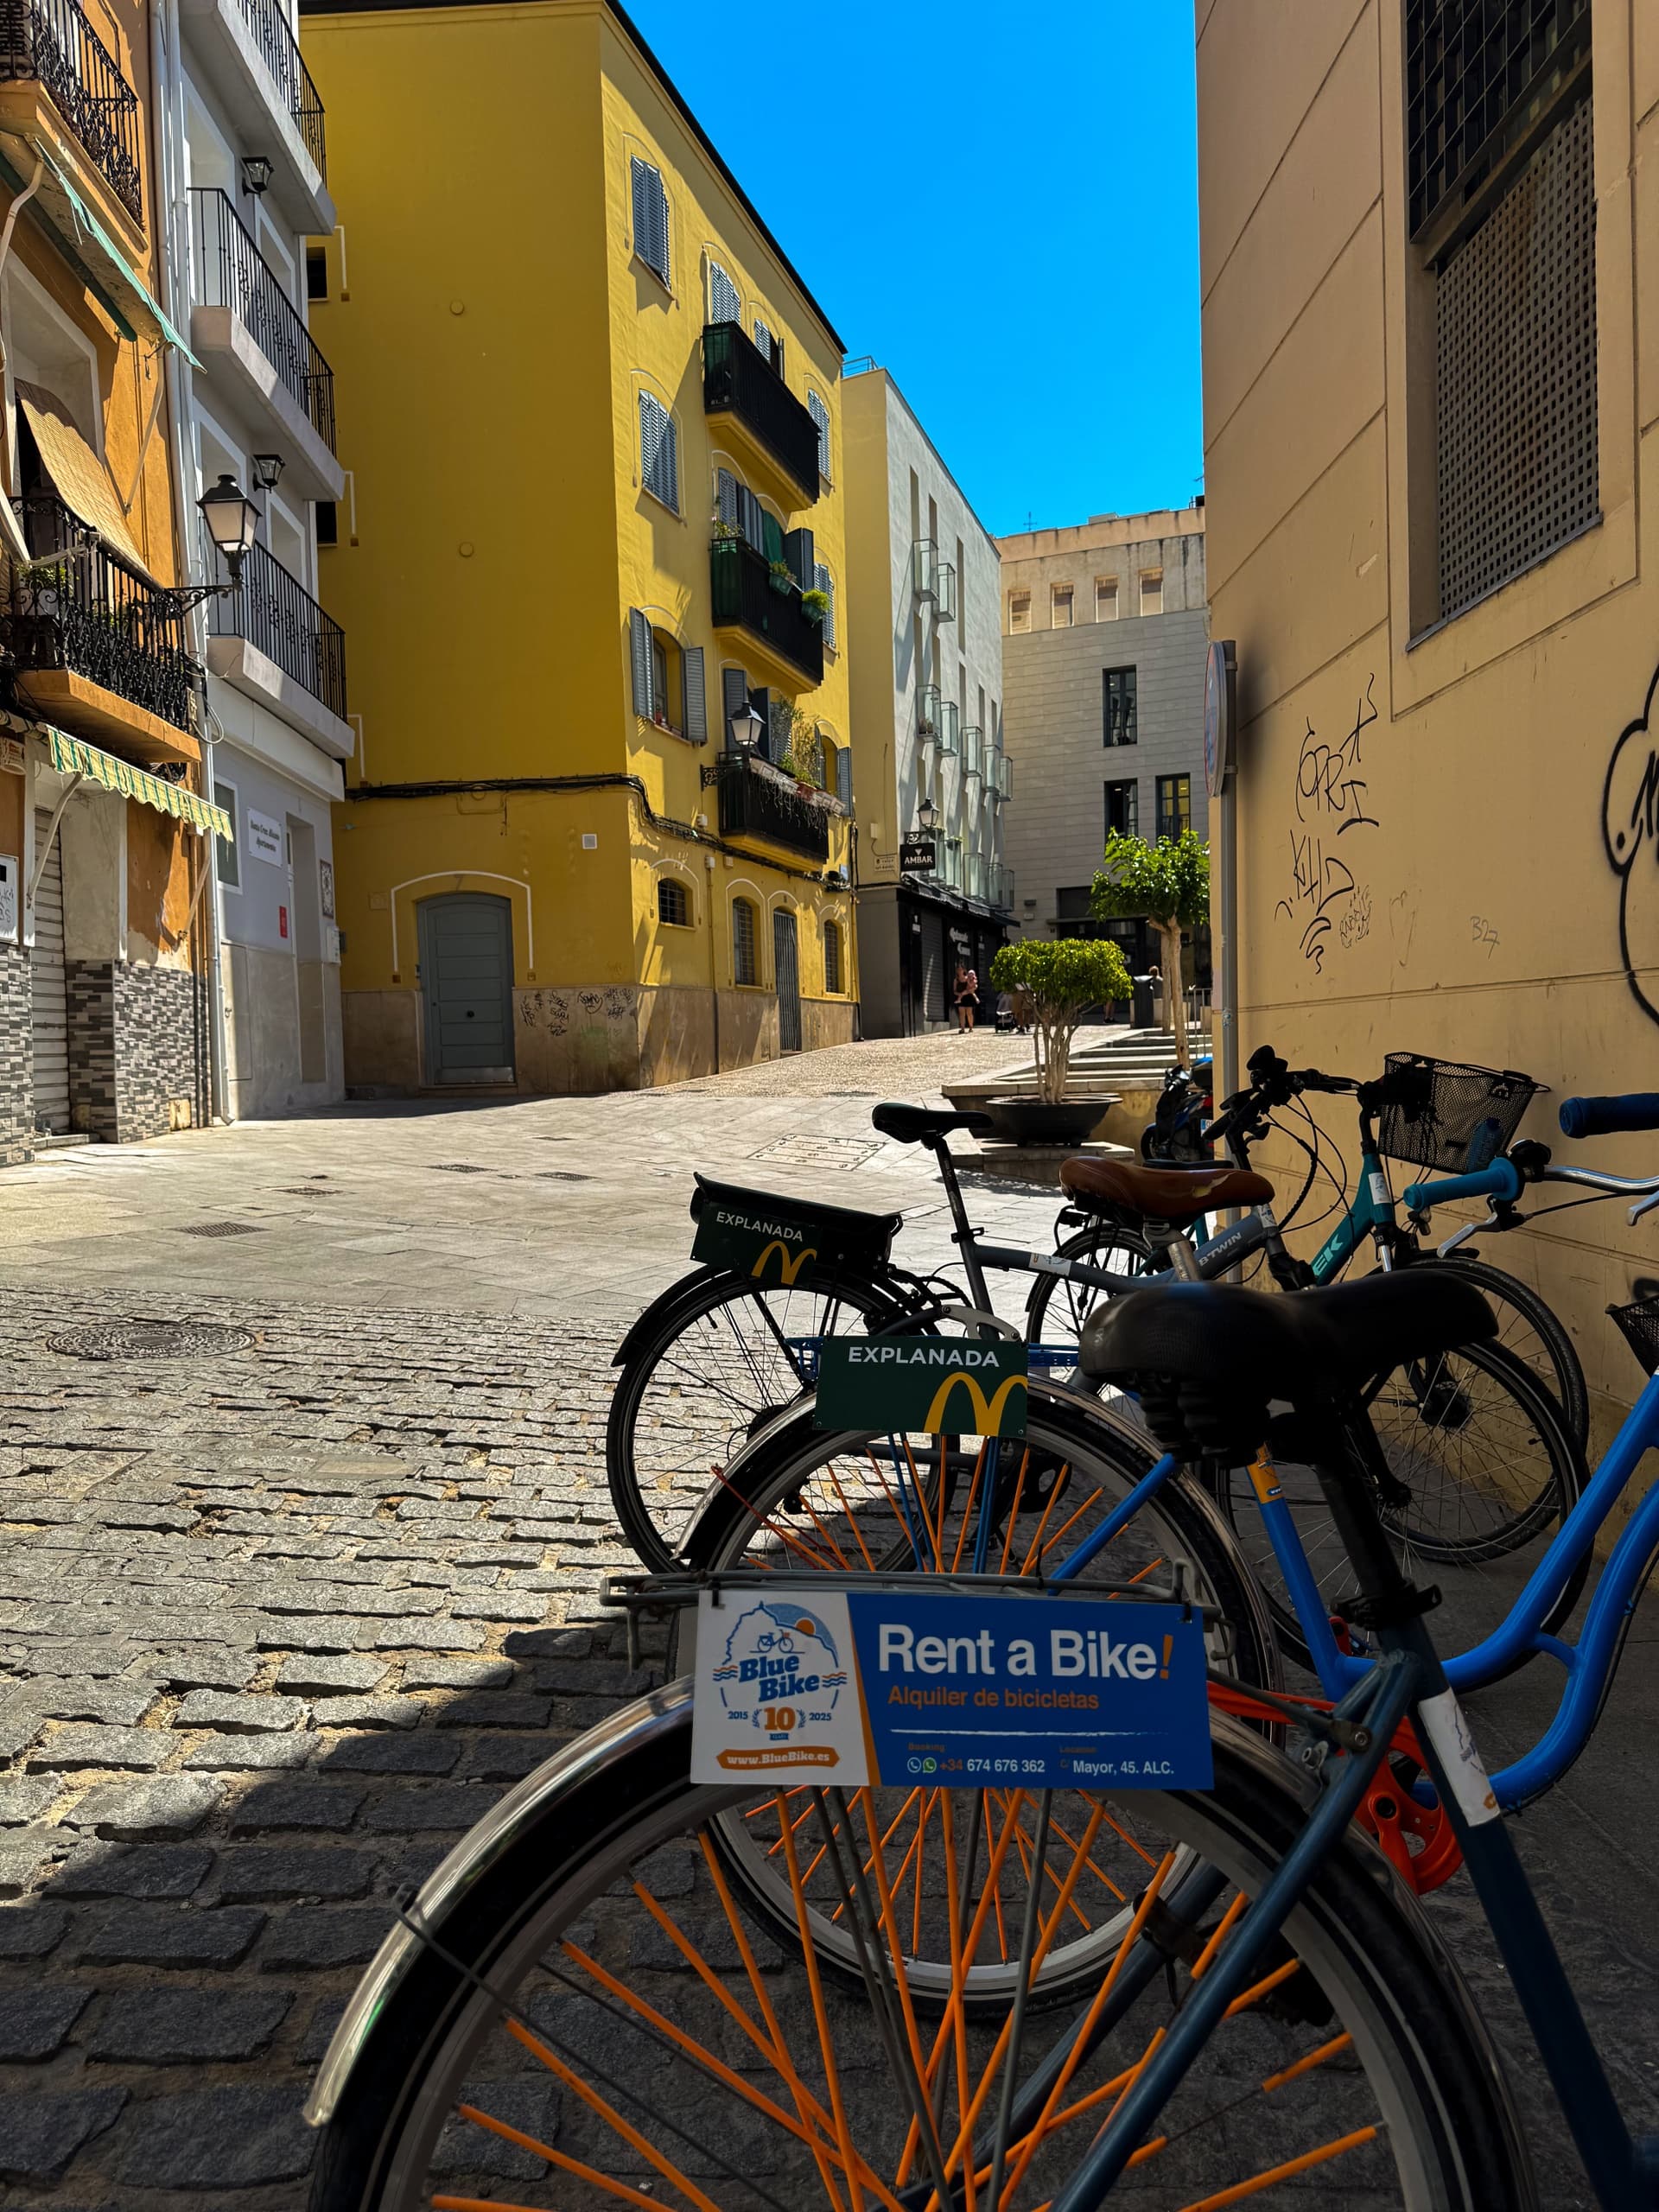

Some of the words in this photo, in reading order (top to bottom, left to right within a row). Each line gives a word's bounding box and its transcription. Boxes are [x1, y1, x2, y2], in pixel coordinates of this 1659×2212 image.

[904, 855, 933, 864] AMBAR
[716, 1211, 803, 1242] EXPLANADA
[1313, 1234, 1344, 1276] EK
[848, 1346, 1000, 1368] EXPLANADA
[879, 1624, 995, 1675] Rent
[1007, 1639, 1037, 1676] a
[1050, 1629, 1173, 1680] Bike!
[739, 1656, 799, 1683] Blue
[759, 1673, 820, 1702] Bike
[887, 1685, 969, 1710] Alquiler
[974, 1688, 999, 1707] de
[1005, 1688, 1099, 1710] bicicletas
[728, 1711, 748, 1719] 2015
[764, 1707, 796, 1731] 10
[809, 1713, 832, 1721] 2025
[727, 1751, 830, 1764] www.BlueBike.es
[967, 1759, 990, 1771] 674
[995, 1759, 1018, 1772] 676
[1021, 1760, 1046, 1773] 362
[1073, 1760, 1117, 1777] Mayor,
[1120, 1761, 1140, 1774] 45.
[1143, 1761, 1174, 1774] ALC.
